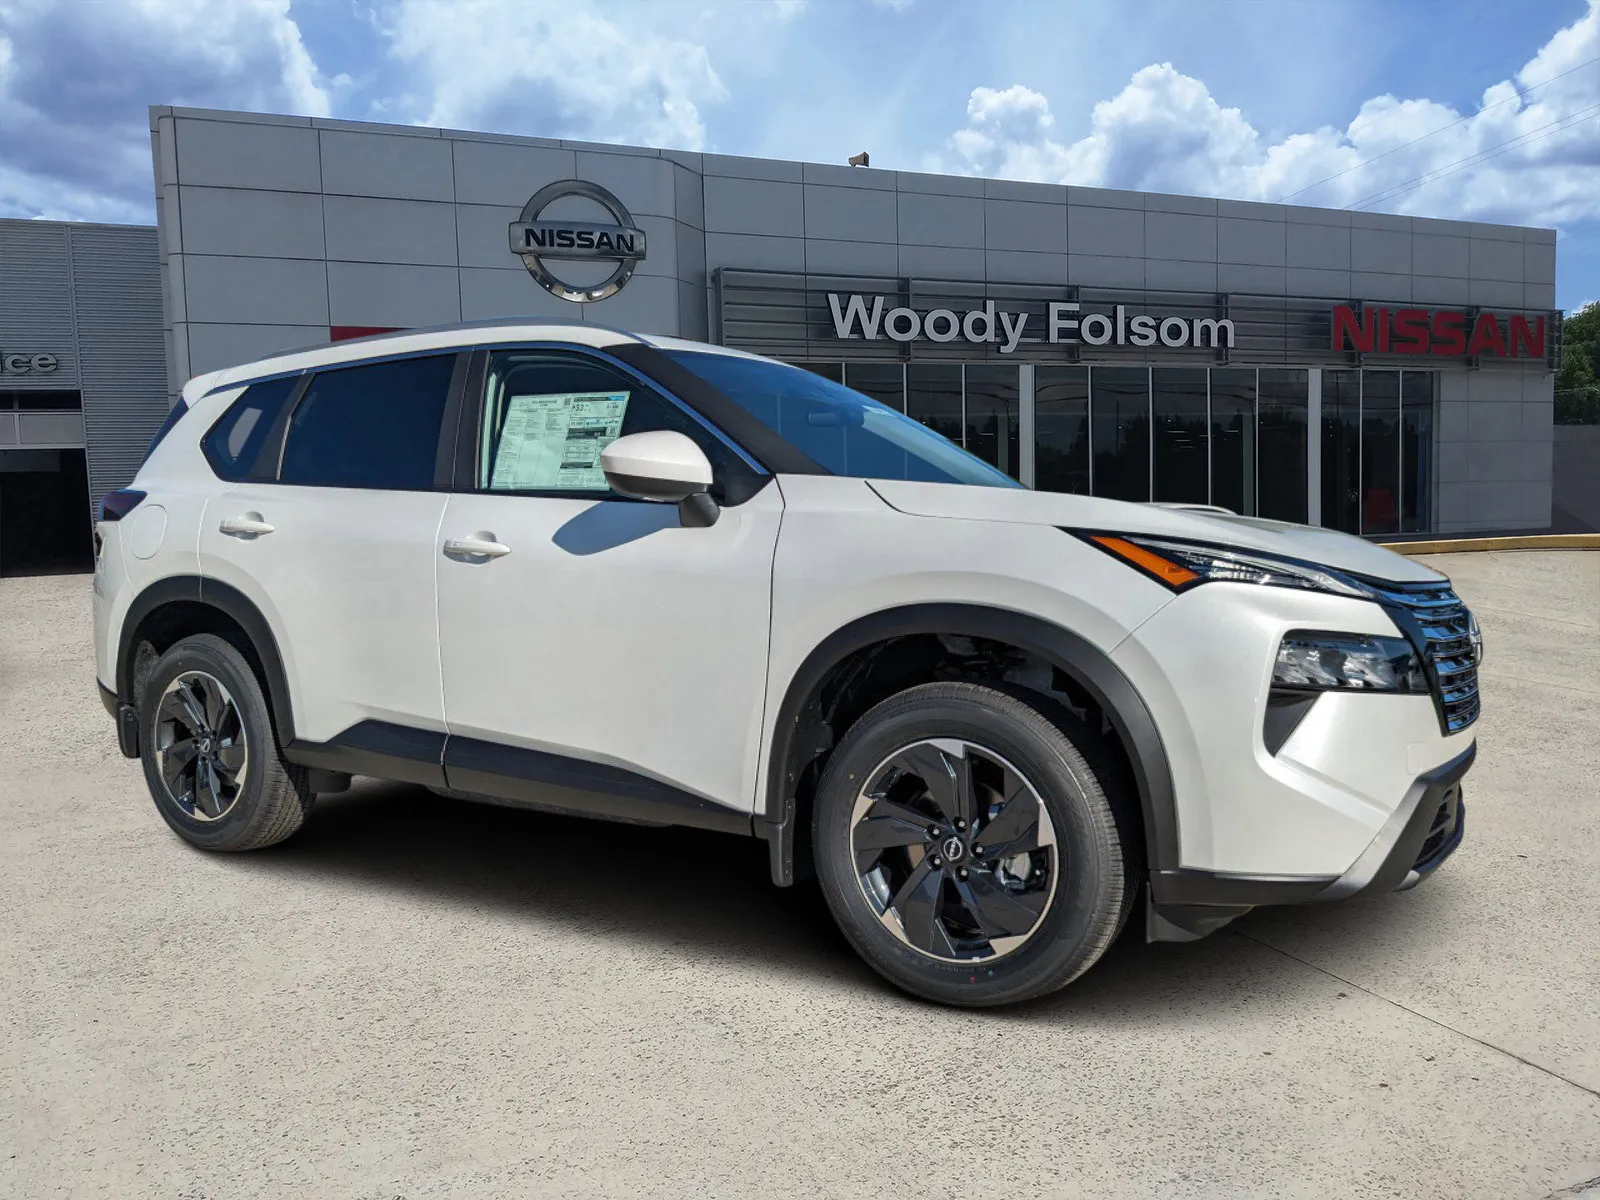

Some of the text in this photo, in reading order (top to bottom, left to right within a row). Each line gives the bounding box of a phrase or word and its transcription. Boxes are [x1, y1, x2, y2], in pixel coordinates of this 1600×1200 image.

[524, 228, 635, 253] NISSAN
[827, 293, 1236, 354] Woody Folsom
[1332, 305, 1546, 358] NISSAN
[0, 353, 58, 374] ce
